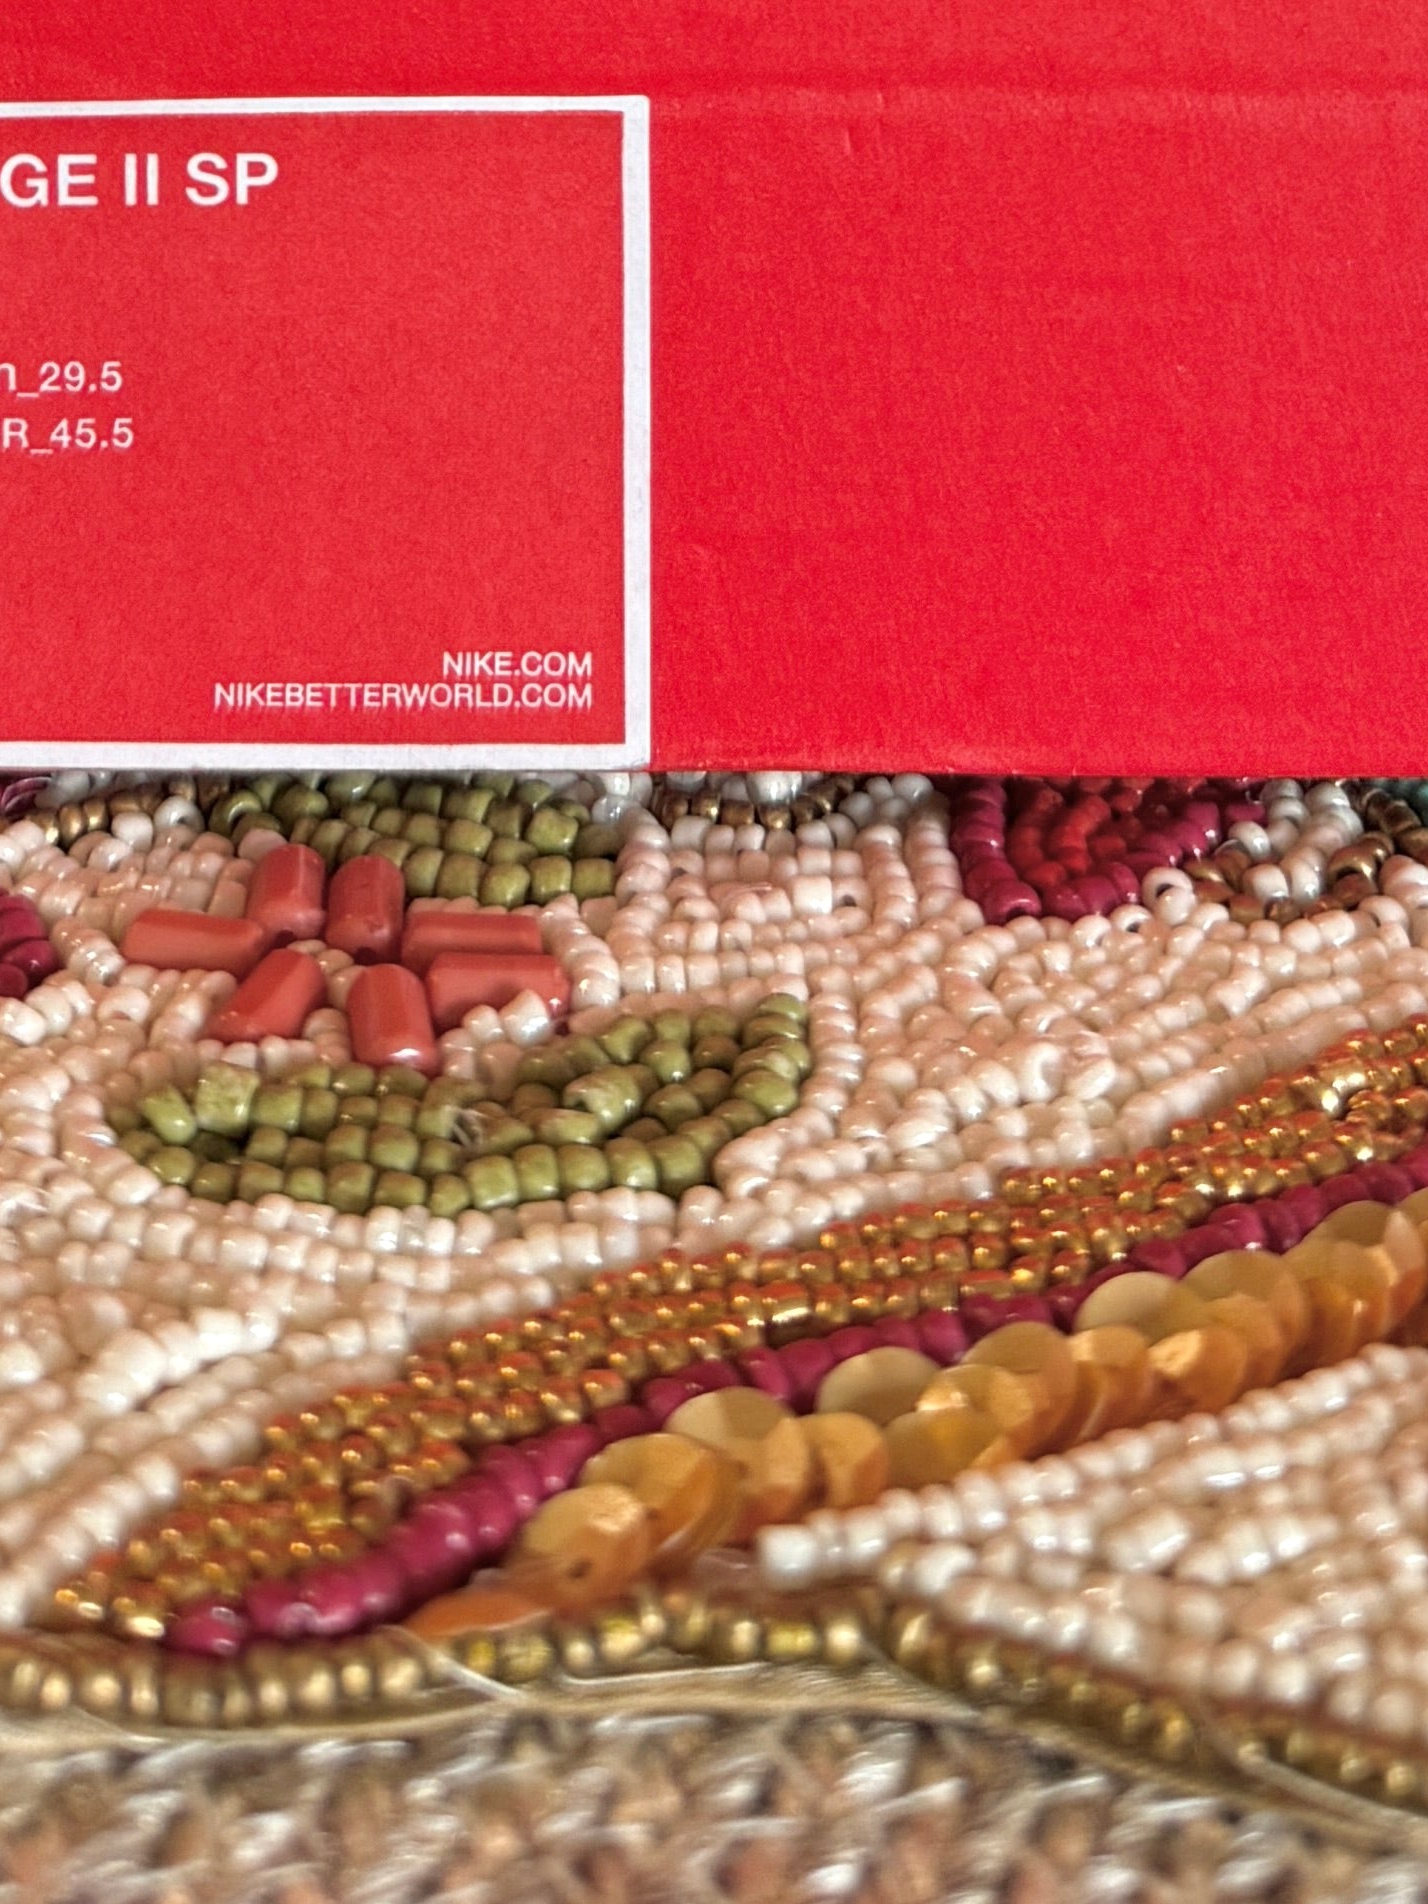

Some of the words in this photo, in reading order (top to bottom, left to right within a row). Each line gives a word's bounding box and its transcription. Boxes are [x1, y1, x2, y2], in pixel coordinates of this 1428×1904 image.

[124, 152, 159, 207] II
[185, 152, 279, 207] SP
[442, 650, 593, 678] NIKE.COM
[214, 682, 593, 710] NIKEBETTERWORLD.COM
